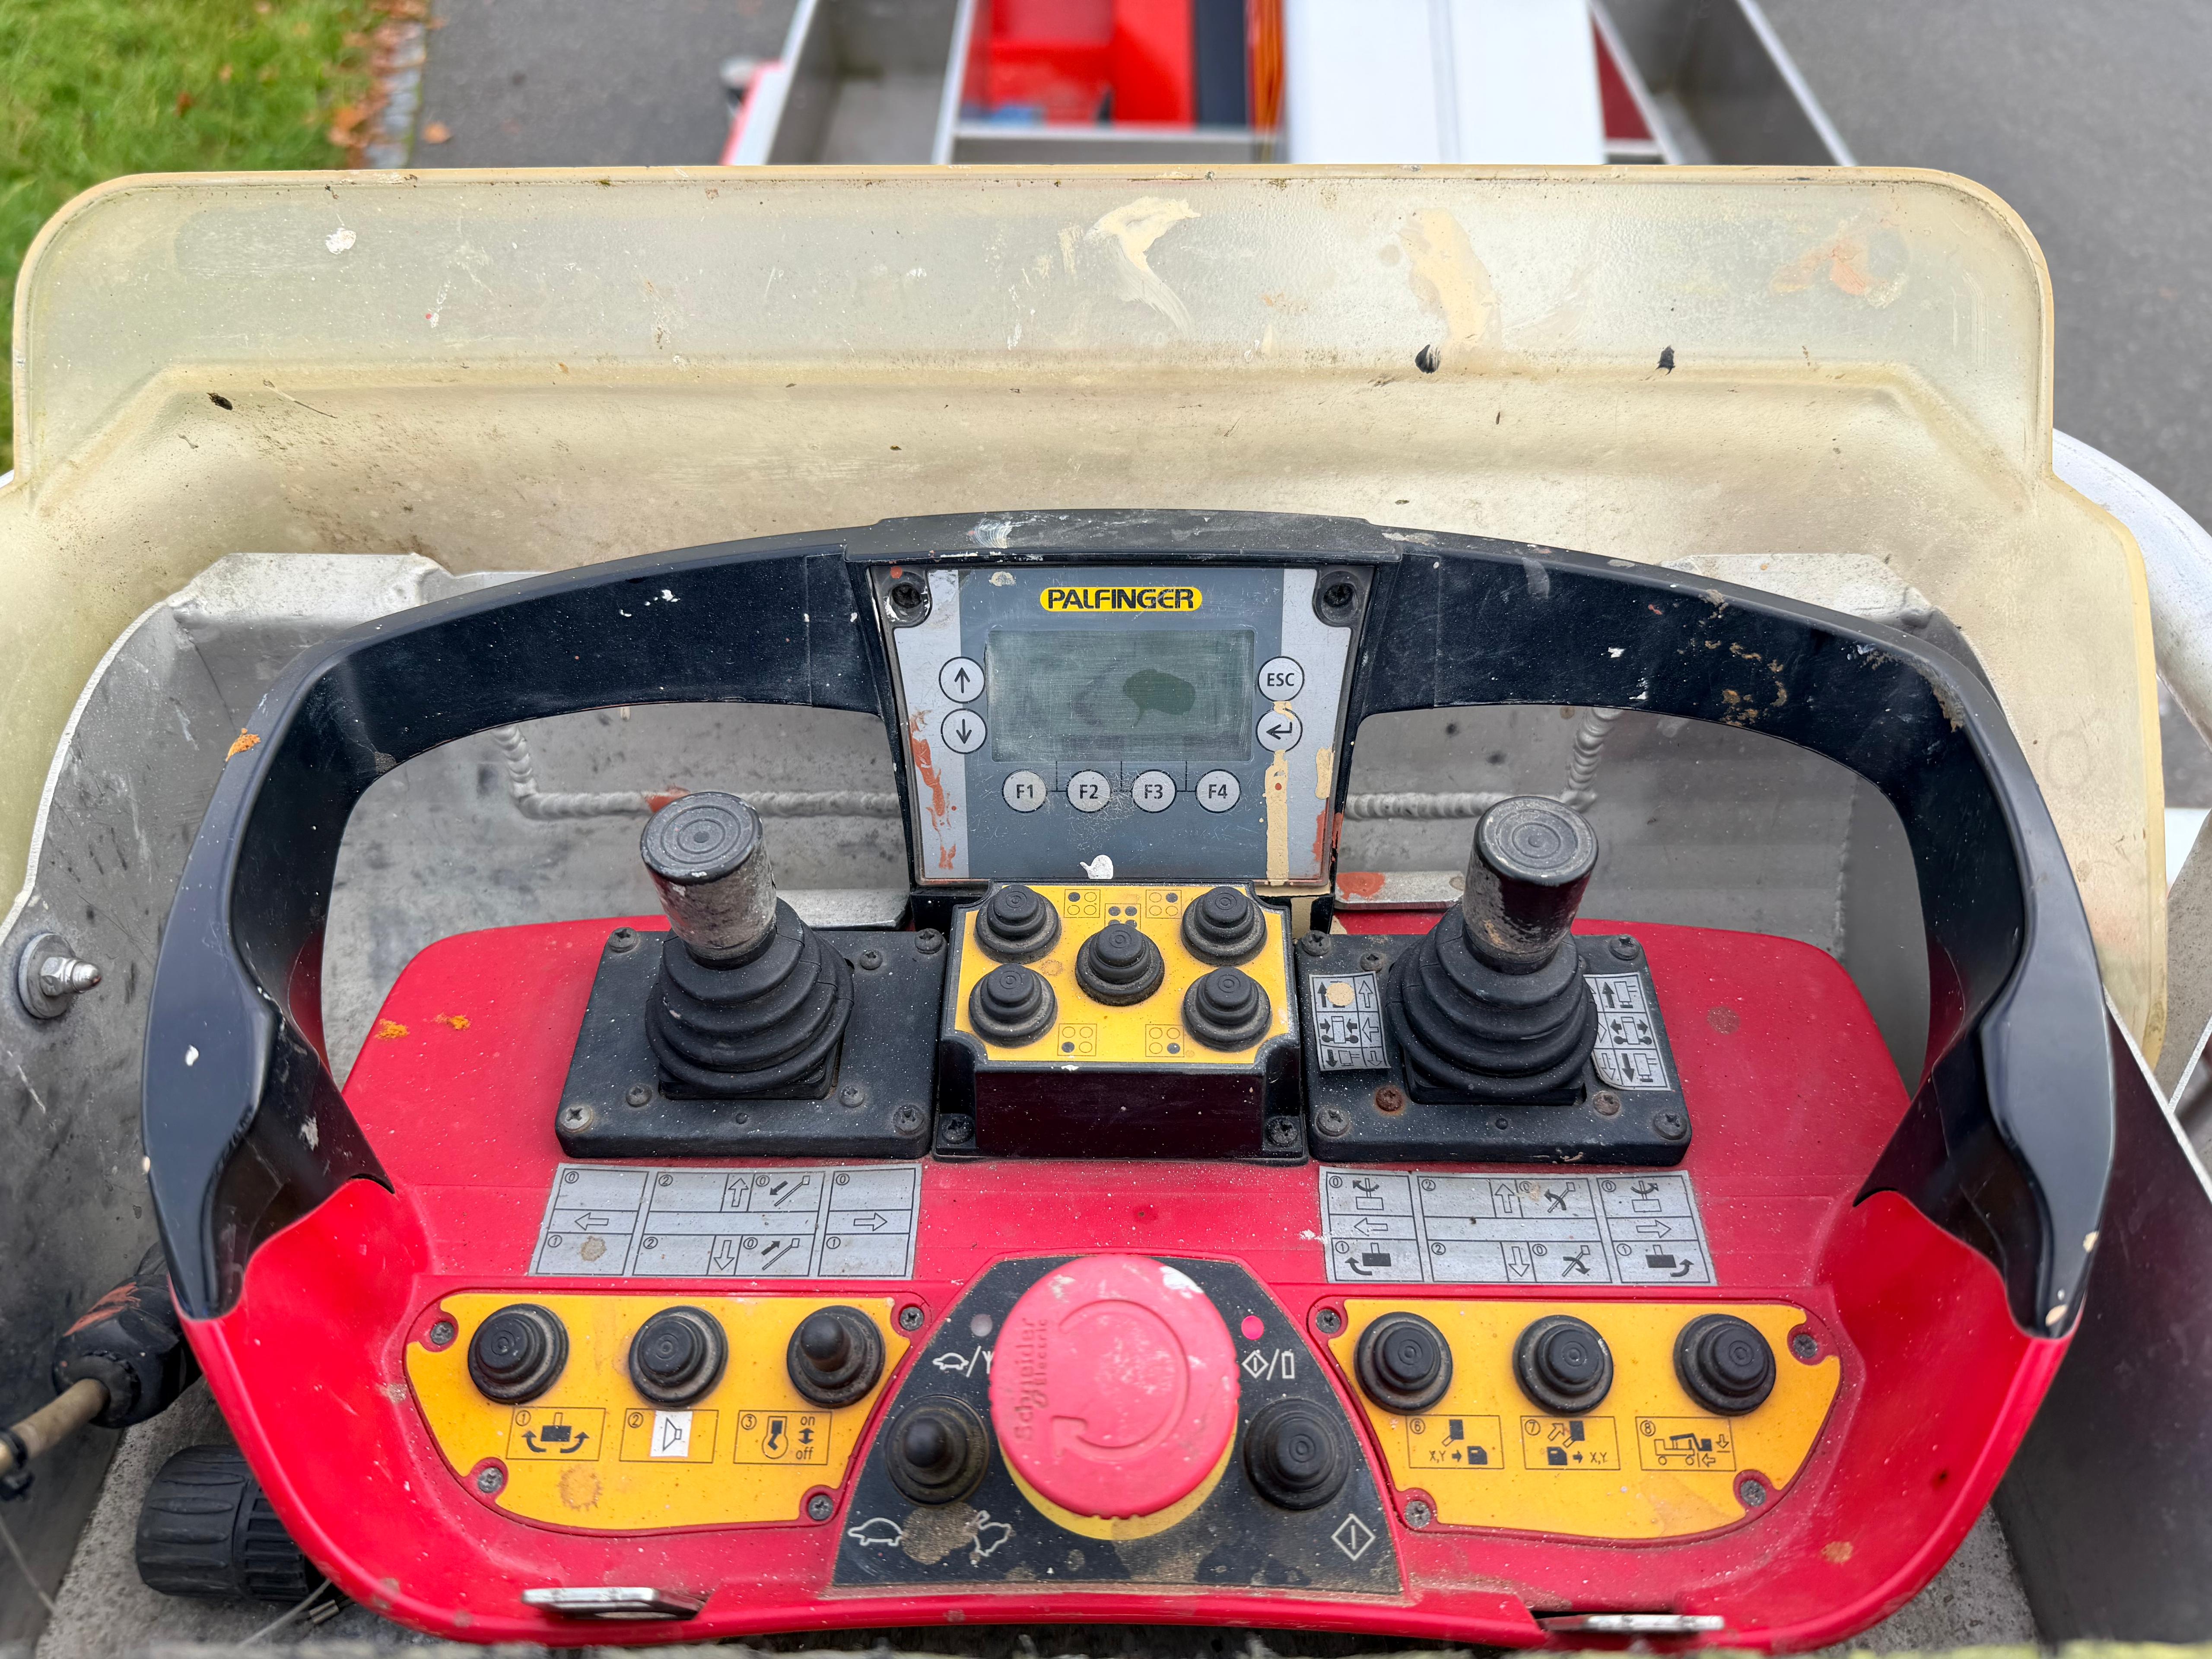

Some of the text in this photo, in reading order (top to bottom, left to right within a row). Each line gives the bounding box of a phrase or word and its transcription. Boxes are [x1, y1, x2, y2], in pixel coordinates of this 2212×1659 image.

[1048, 589, 1194, 609] PALFINGER
[1267, 672, 1295, 687] ESC
[1016, 784, 1034, 799] F1
[1080, 784, 1099, 799] F2
[1144, 784, 1163, 799] F3
[1208, 784, 1228, 799] F4
[800, 1416, 816, 1426] on
[795, 1446, 814, 1460] off
